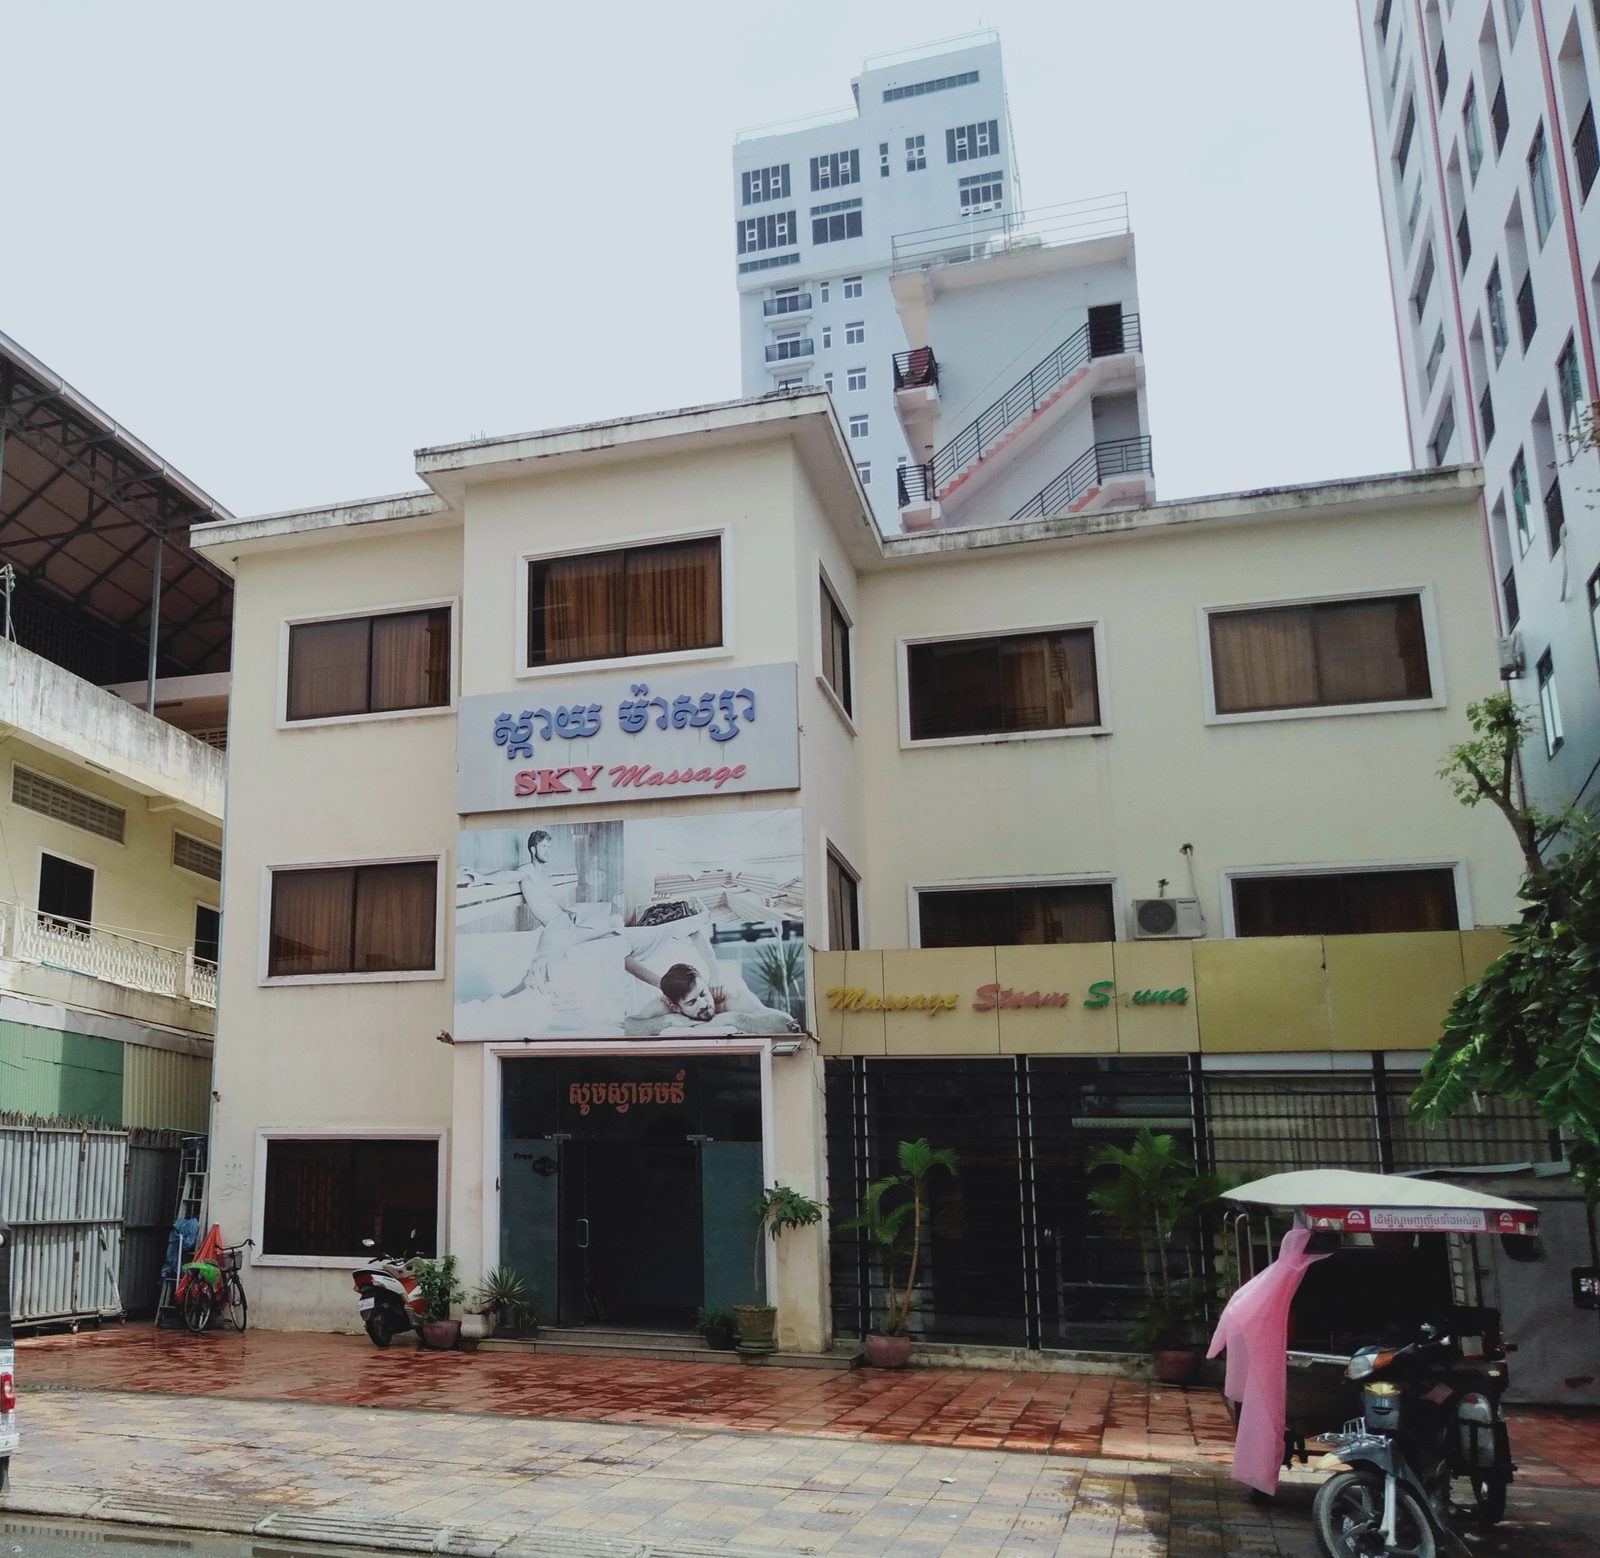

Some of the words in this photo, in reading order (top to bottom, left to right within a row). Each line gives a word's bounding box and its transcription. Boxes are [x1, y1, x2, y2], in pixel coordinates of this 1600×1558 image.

[514, 764, 604, 797] SKY
[607, 764, 748, 789] Massage
[826, 985, 960, 1017] Massage
[971, 983, 1070, 1012] Steam
[1083, 980, 1190, 1009] Suna
